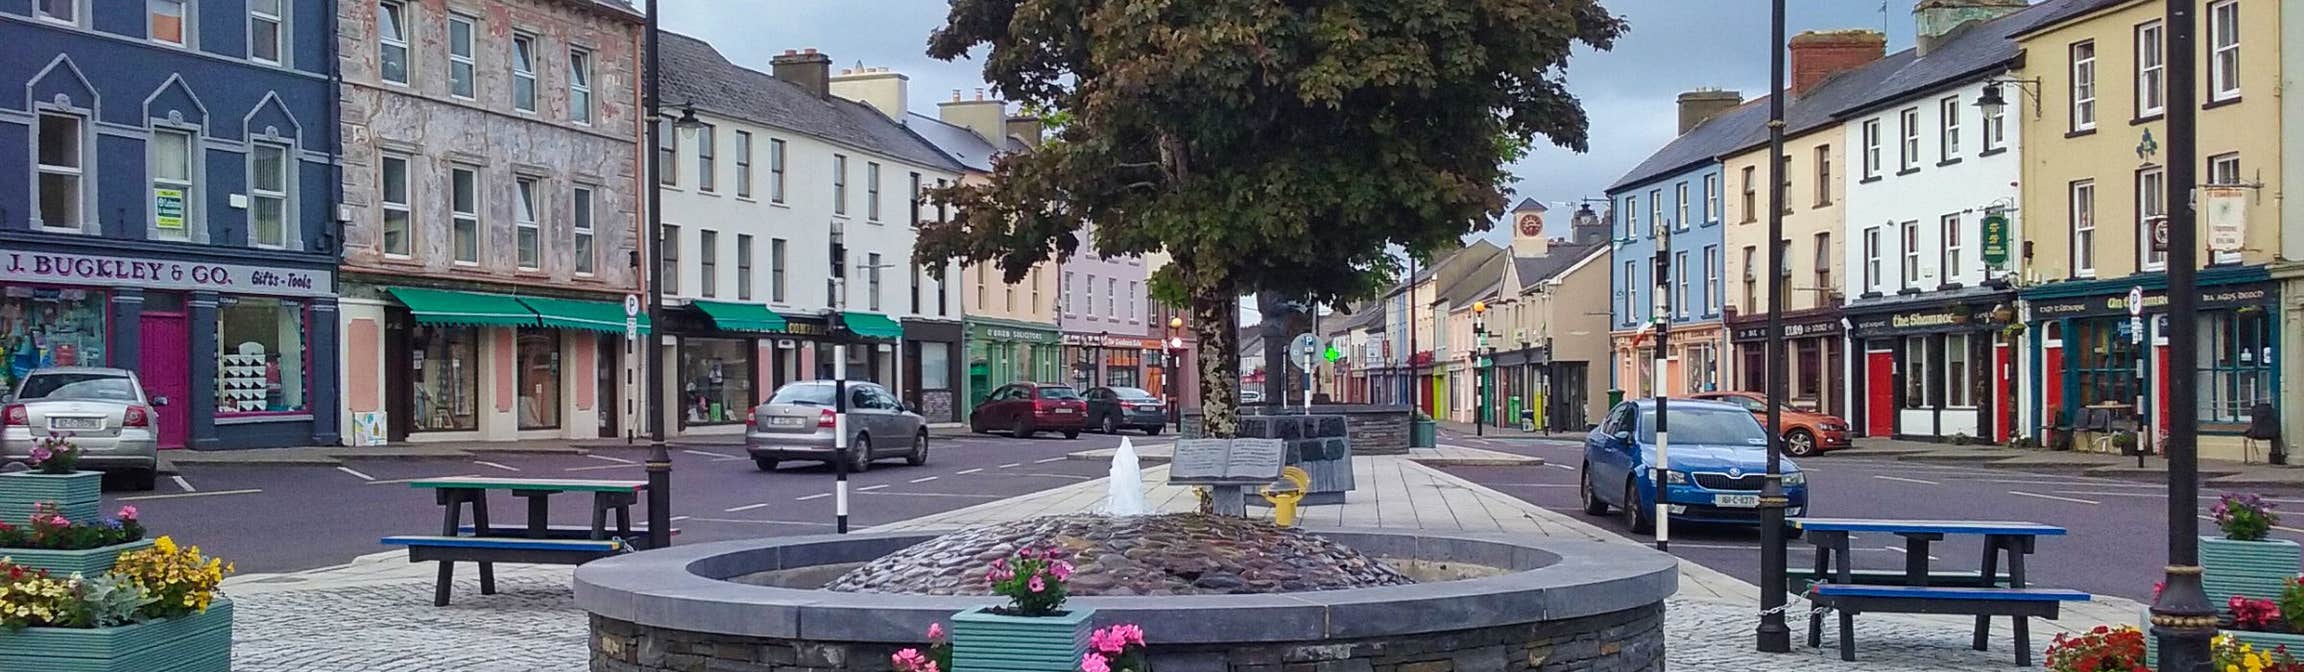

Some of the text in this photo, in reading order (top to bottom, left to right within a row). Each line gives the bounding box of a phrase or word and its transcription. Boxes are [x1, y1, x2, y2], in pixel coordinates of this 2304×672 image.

[6, 253, 25, 273] J.
[170, 264, 184, 281] &
[251, 270, 279, 287] Gifts
[287, 272, 312, 289] Tools
[1306, 336, 1313, 345] P
